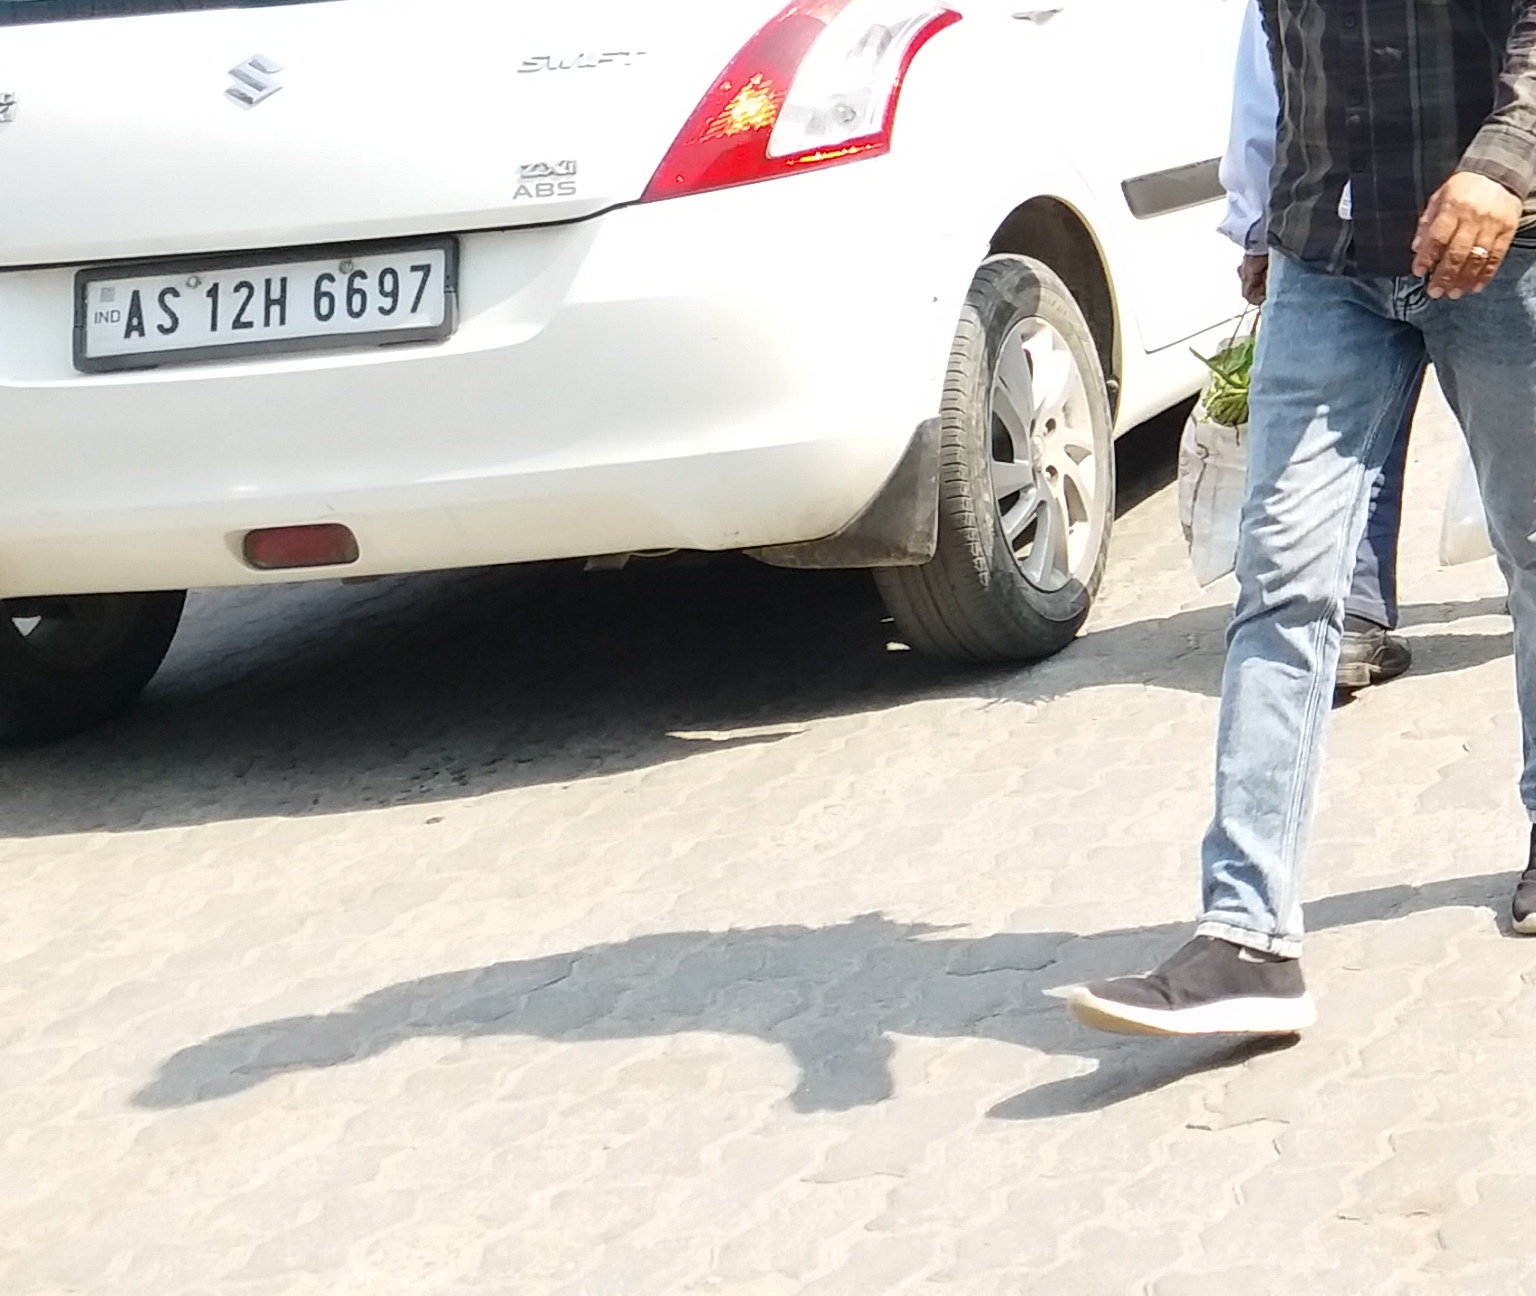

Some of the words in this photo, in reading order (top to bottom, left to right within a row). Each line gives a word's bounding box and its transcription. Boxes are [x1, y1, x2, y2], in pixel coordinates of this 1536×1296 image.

[512, 181, 577, 199] ABS
[94, 310, 121, 325] IND
[206, 277, 288, 333] 12H
[313, 263, 433, 323] 6697
